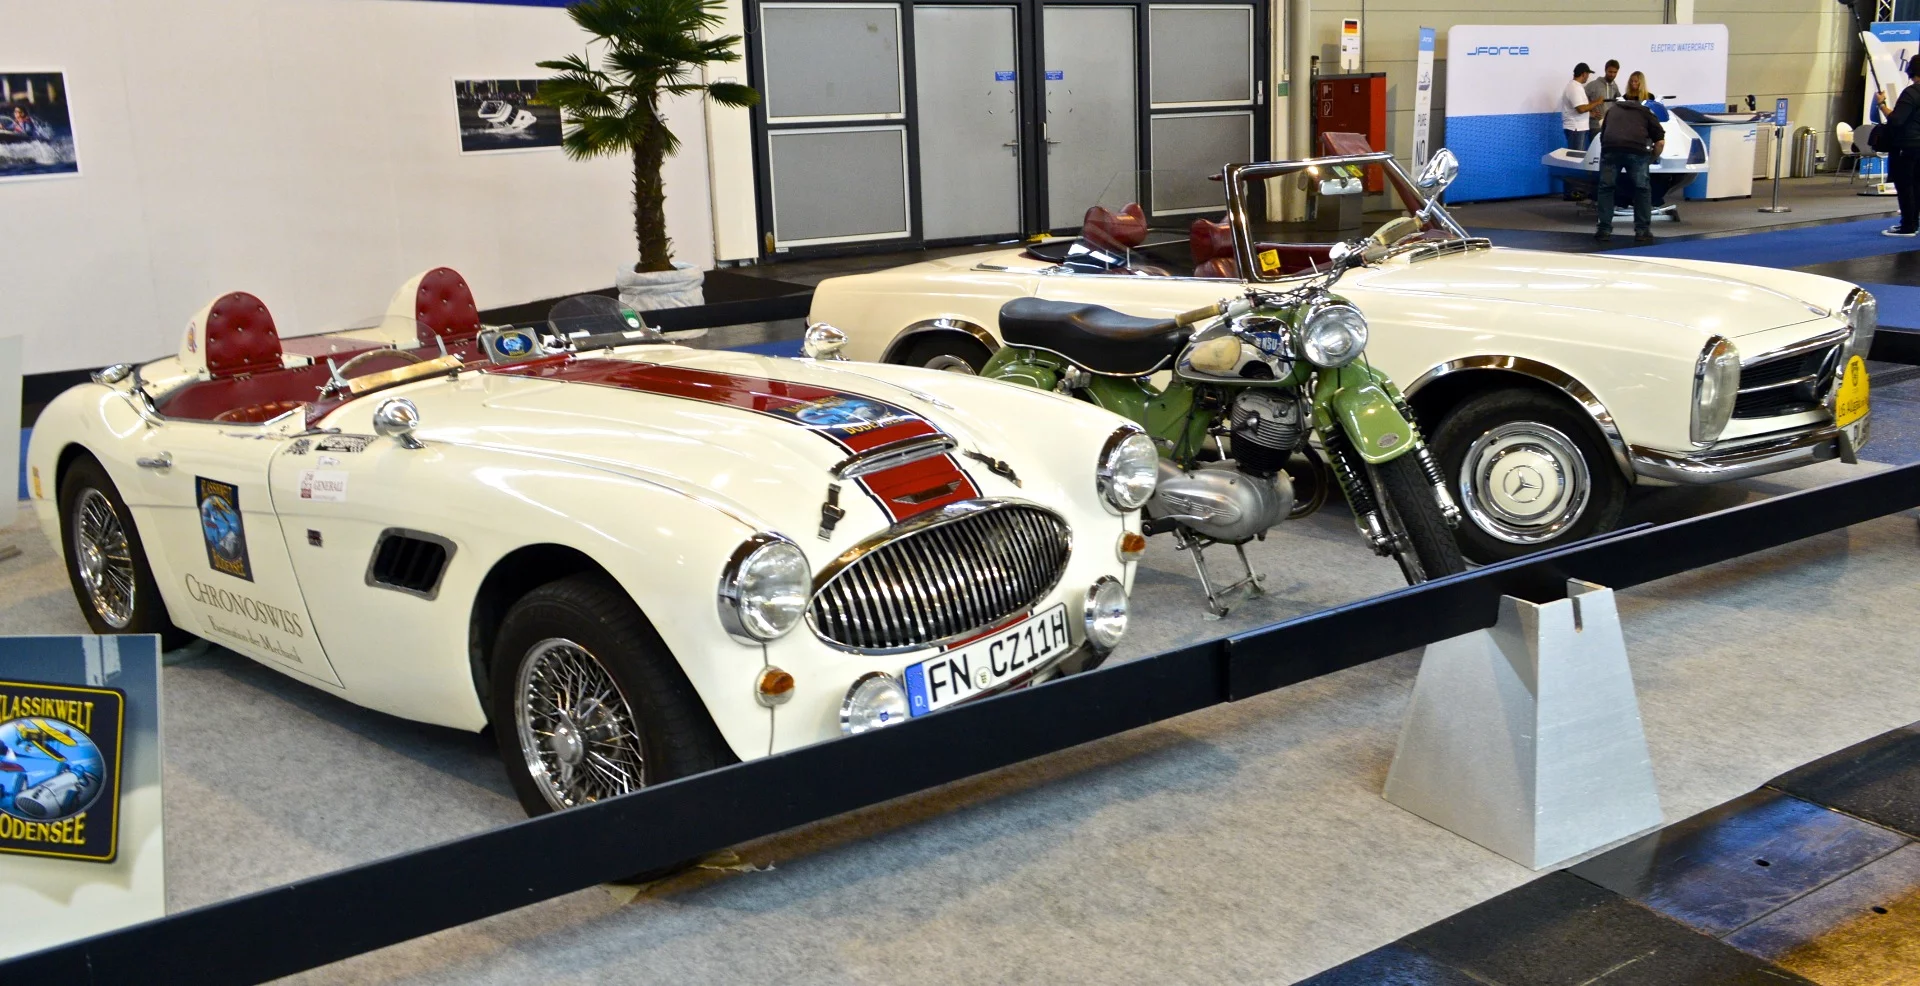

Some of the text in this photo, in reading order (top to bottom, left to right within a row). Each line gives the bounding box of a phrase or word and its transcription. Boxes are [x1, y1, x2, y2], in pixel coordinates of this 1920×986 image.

[1651, 42, 1715, 52] ELECTRIC WATERCRAFTS
[1261, 337, 1278, 350] NSU
[185, 573, 304, 638] CHRONOSWISS
[928, 610, 1066, 703] FN CZ11H
[0, 694, 94, 734] LASSIKWELT
[914, 695, 923, 707] D
[0, 811, 86, 844] ODENSEE
